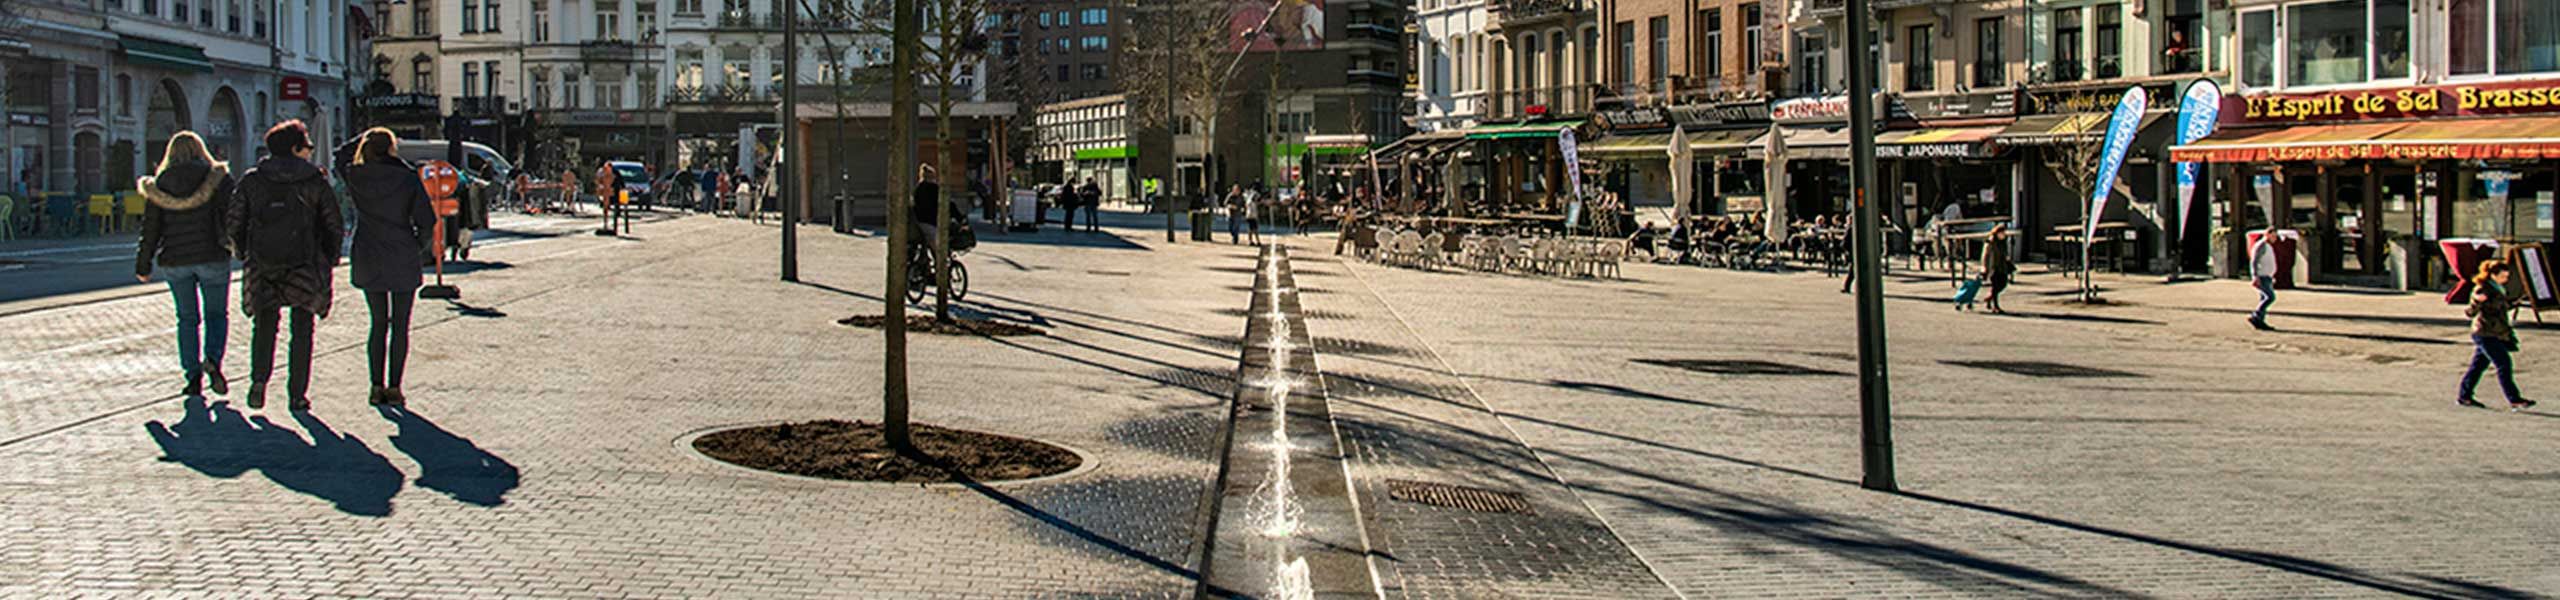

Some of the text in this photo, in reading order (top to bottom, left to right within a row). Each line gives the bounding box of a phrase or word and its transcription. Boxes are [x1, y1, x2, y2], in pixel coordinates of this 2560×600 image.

[2245, 94, 2344, 121] L'Esprit
[2353, 92, 2385, 113] de
[2396, 88, 2439, 111] Sel
[1875, 143, 1969, 158] ISINE JAPONAISE
[2326, 146, 2344, 159] de
[2350, 145, 2374, 159] Sel
[2383, 144, 2458, 158] Brasserie
